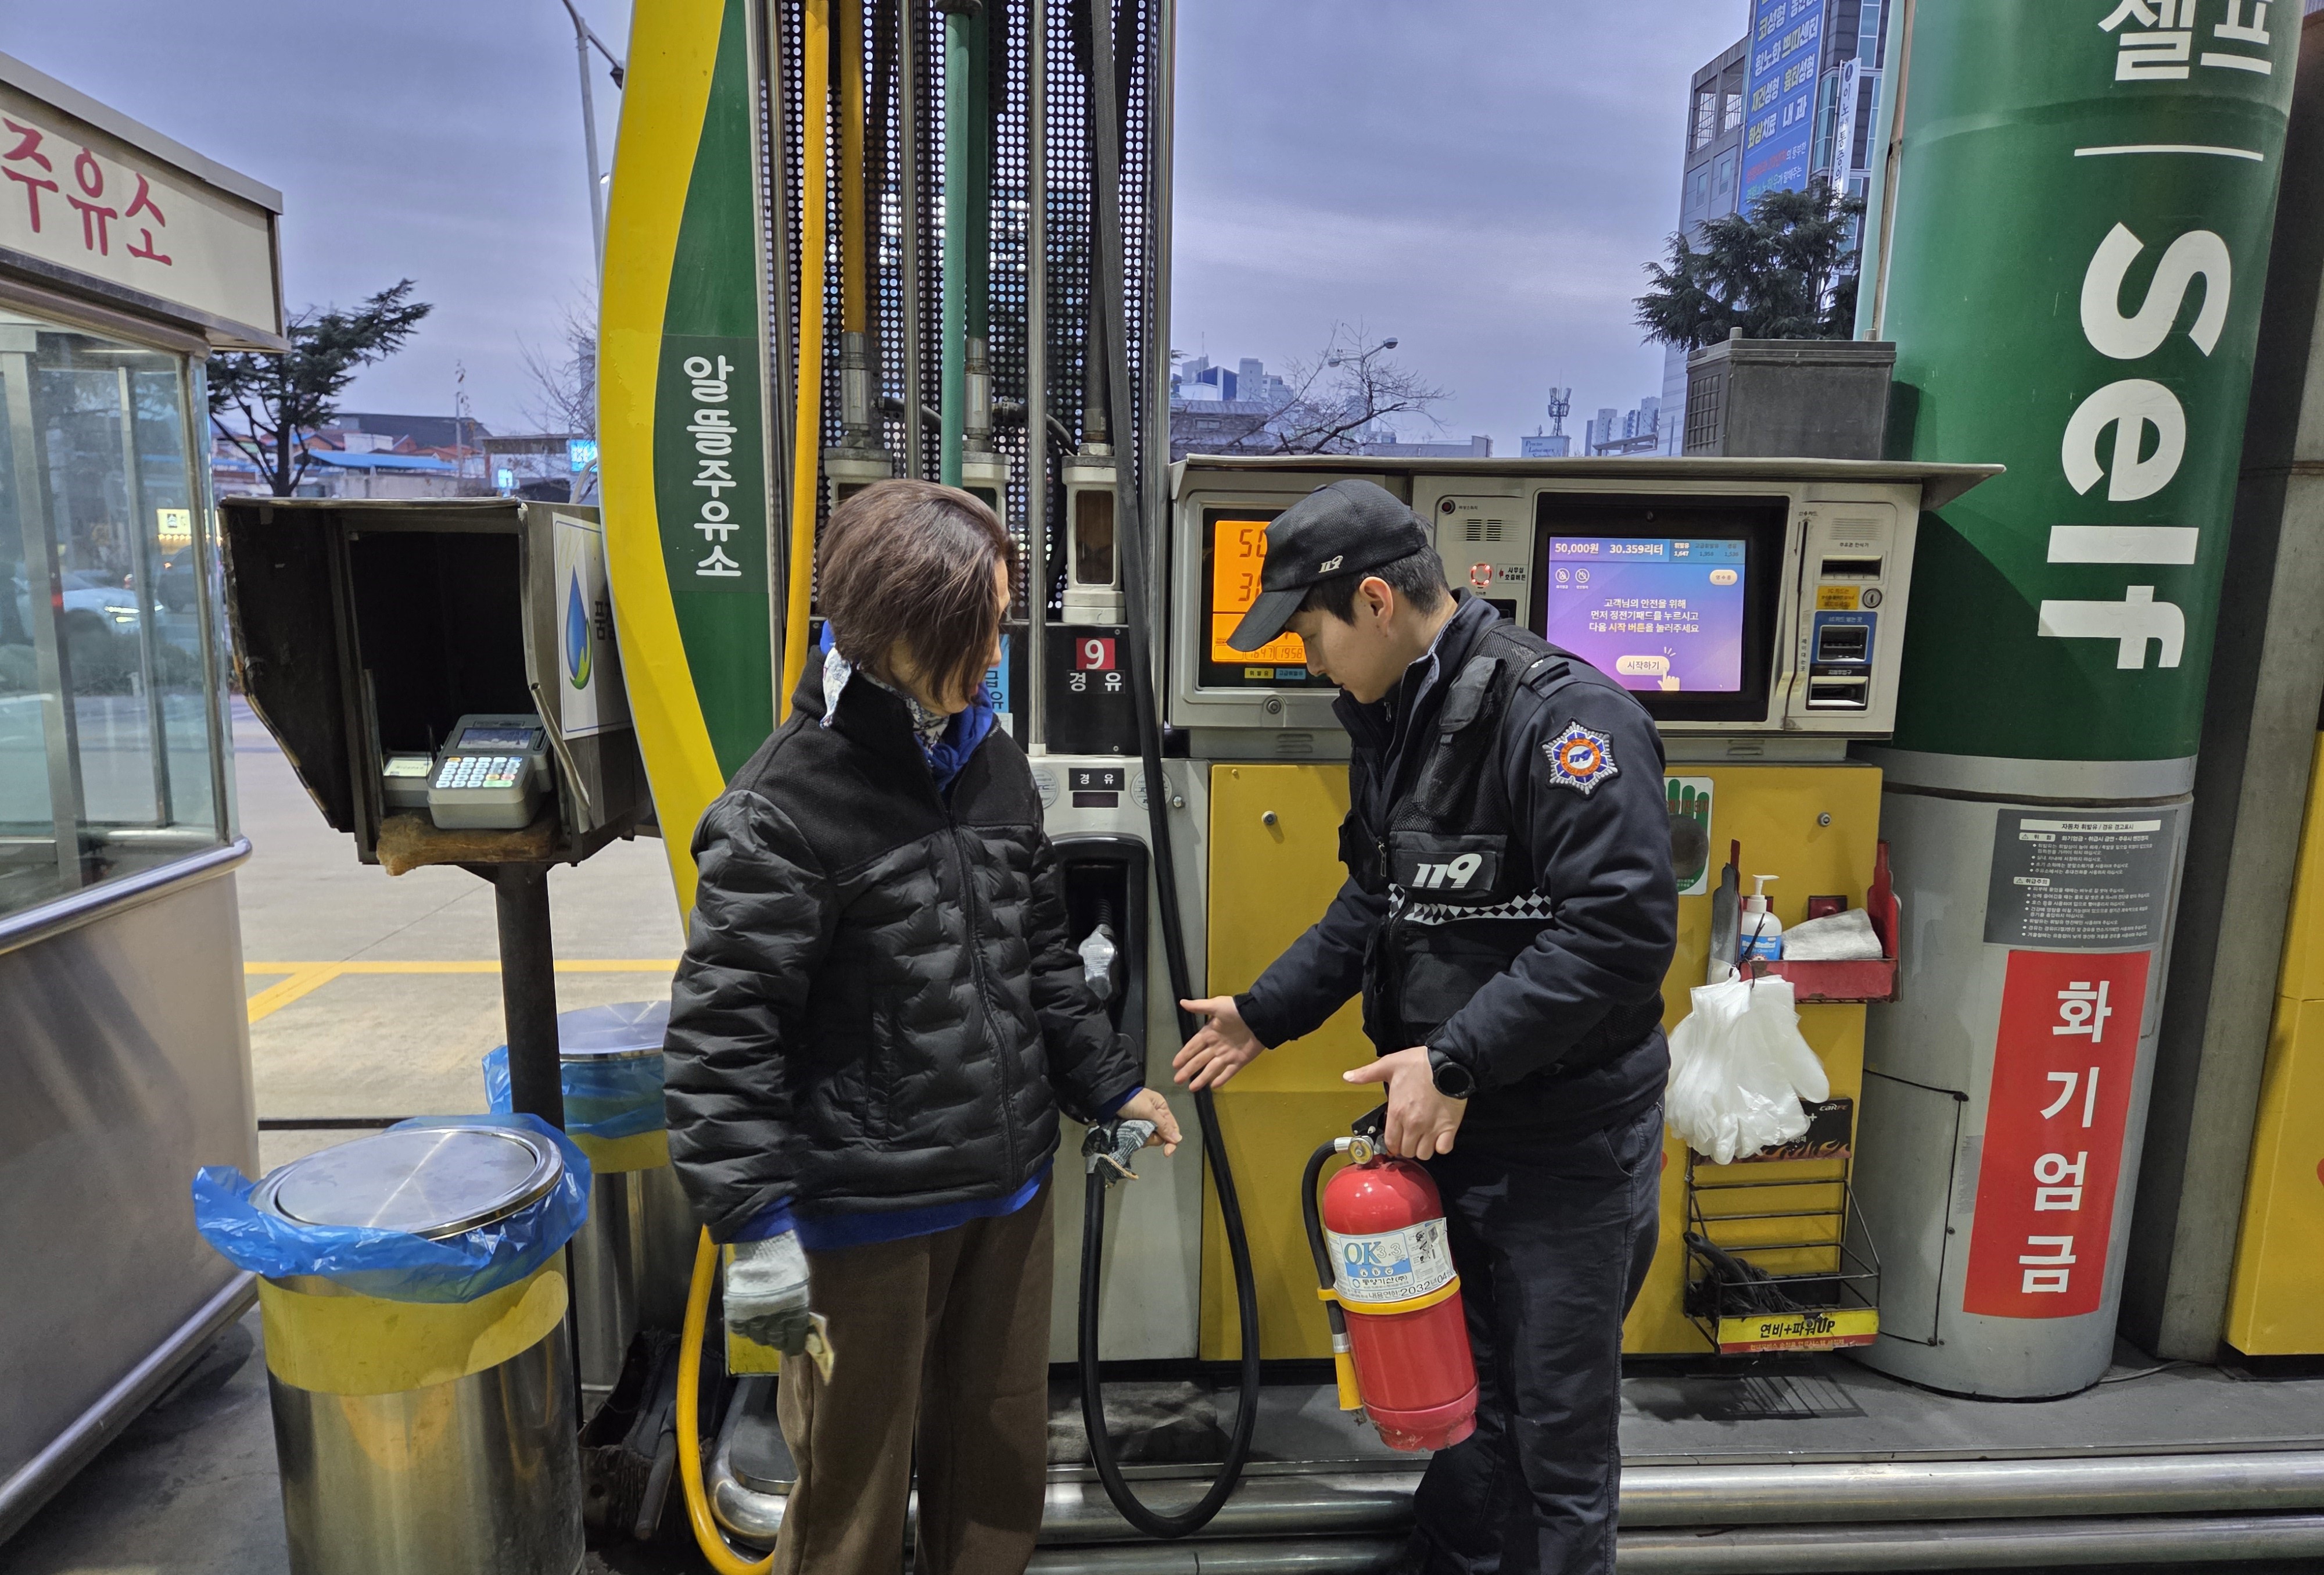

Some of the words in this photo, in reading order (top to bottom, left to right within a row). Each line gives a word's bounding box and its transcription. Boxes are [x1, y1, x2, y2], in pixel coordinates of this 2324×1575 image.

[1758, 2, 1786, 41] 코성형
[2097, 0, 2272, 81] 셀프
[1755, 40, 1781, 77] 항노화
[1784, 53, 1815, 92] 흉터성형
[1748, 112, 1777, 149] 화상치료
[1, 119, 172, 267] 주유소
[2038, 222, 2231, 670] Self
[683, 355, 741, 577] 알뜰주유소
[1318, 556, 1343, 573] 119
[1555, 543, 1599, 555] 50,000원
[1609, 543, 1663, 556] 30.359리터
[1591, 610, 1608, 620] 먼저
[1610, 610, 1662, 621] 정전기패드를
[1664, 611, 1699, 621] 누르시고
[1604, 599, 1638, 608] 고객님의
[1641, 599, 1667, 608] 안전을
[1669, 599, 1686, 609] 위해
[1589, 622, 1606, 632] 다음
[1609, 622, 1626, 632] 시작
[1628, 622, 1654, 632] 버튼을
[1656, 623, 1699, 633] 눌러주세요
[1085, 639, 1104, 670] 9
[1281, 648, 1303, 658] 1958
[1627, 661, 1659, 670] 시작하기
[1412, 853, 1482, 888] 119
[2018, 980, 2113, 1294] 화기엄금
[1344, 1241, 1381, 1265] OK
[1376, 1243, 1402, 1258] 3.3
